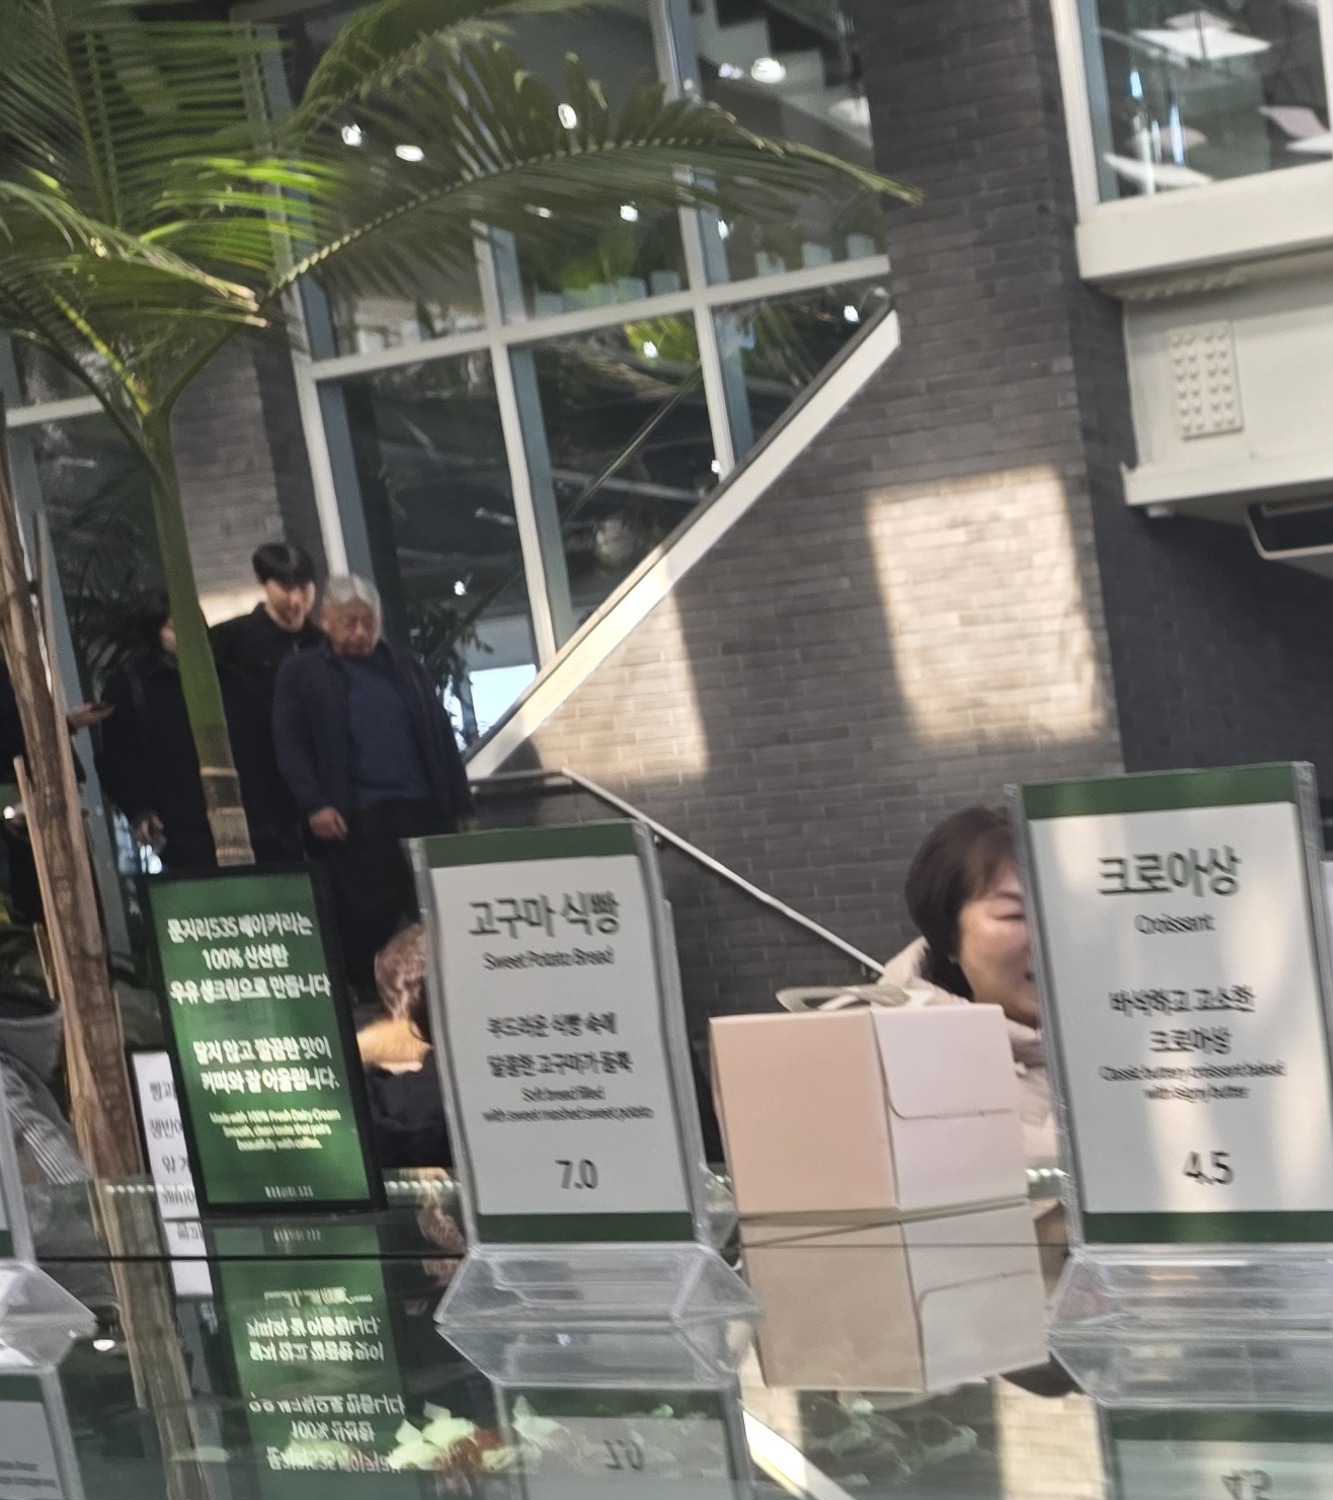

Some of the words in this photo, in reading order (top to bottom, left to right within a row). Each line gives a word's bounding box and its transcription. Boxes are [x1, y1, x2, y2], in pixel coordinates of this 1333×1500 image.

[1097, 845, 1241, 897] 크로아상
[167, 915, 239, 943] 문지리535
[238, 911, 313, 938] 베이커리는
[468, 893, 556, 940] 고구마
[560, 890, 621, 936] 식빵
[1134, 913, 1217, 936] Croissant
[202, 946, 244, 970] 100%
[244, 943, 289, 970] 신선한
[483, 952, 531, 970] Sweet
[572, 945, 615, 966] Bread
[169, 979, 200, 1005] 우유
[200, 976, 271, 1004] 생크림으로
[269, 972, 332, 999] 만듭니다
[1108, 987, 1194, 1018] 바삭하고
[1193, 984, 1257, 1014] 고소한
[552, 1012, 583, 1037] 식빵
[1149, 1026, 1234, 1055] 크로아상
[537, 1051, 601, 1076] 고구마가
[200, 1068, 245, 1095] 커피와
[244, 1068, 261, 1093] 잘
[262, 1065, 340, 1092] 어울립니다.
[554, 1158, 599, 1189] 7.0
[1183, 1149, 1236, 1186] 4.5
